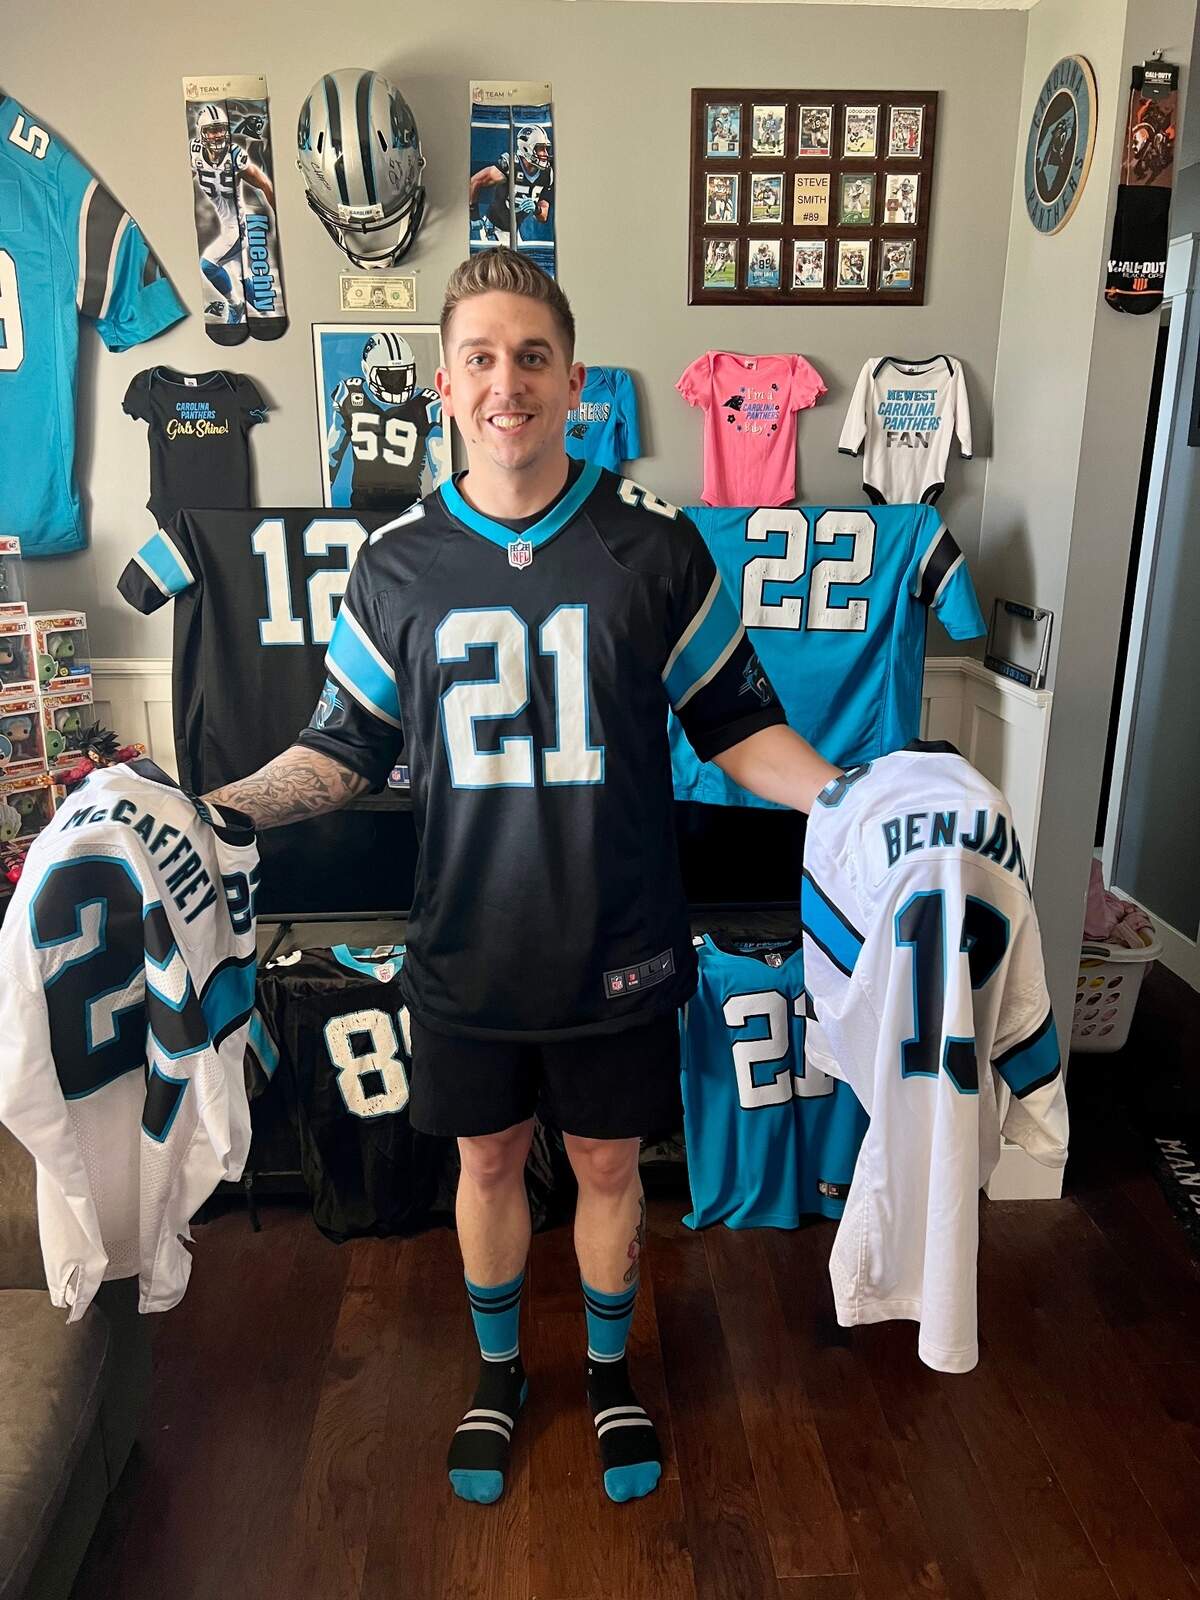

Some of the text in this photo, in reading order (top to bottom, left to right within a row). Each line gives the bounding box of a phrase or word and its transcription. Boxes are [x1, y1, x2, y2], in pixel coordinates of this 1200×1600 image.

[1034, 61, 1084, 130] CAROLINA
[8, 112, 51, 161] 5
[797, 177, 828, 187] STEVE
[797, 195, 827, 205] SMITH
[1028, 155, 1084, 233] PANTHERS
[803, 212, 819, 222] #89
[244, 213, 277, 312] Kuechly
[758, 257, 771, 269] 89
[886, 389, 938, 401] NEWEST
[176, 402, 210, 411] CAROLINA
[742, 403, 774, 412] CAROLINA
[878, 402, 936, 416] CAROLINA
[181, 410, 217, 420] PANTHERS
[745, 411, 780, 420] PANTHERS
[167, 418, 229, 440] Girls Shine!
[883, 416, 942, 431] PANTHERS
[351, 411, 418, 467] 59
[886, 431, 931, 449] FAN
[512, 551, 530, 563] NFL
[742, 507, 877, 631] 22
[253, 518, 369, 646] 12
[434, 603, 606, 790] 21
[59, 798, 219, 925] McCAFFREY
[323, 1003, 412, 1119] 8
